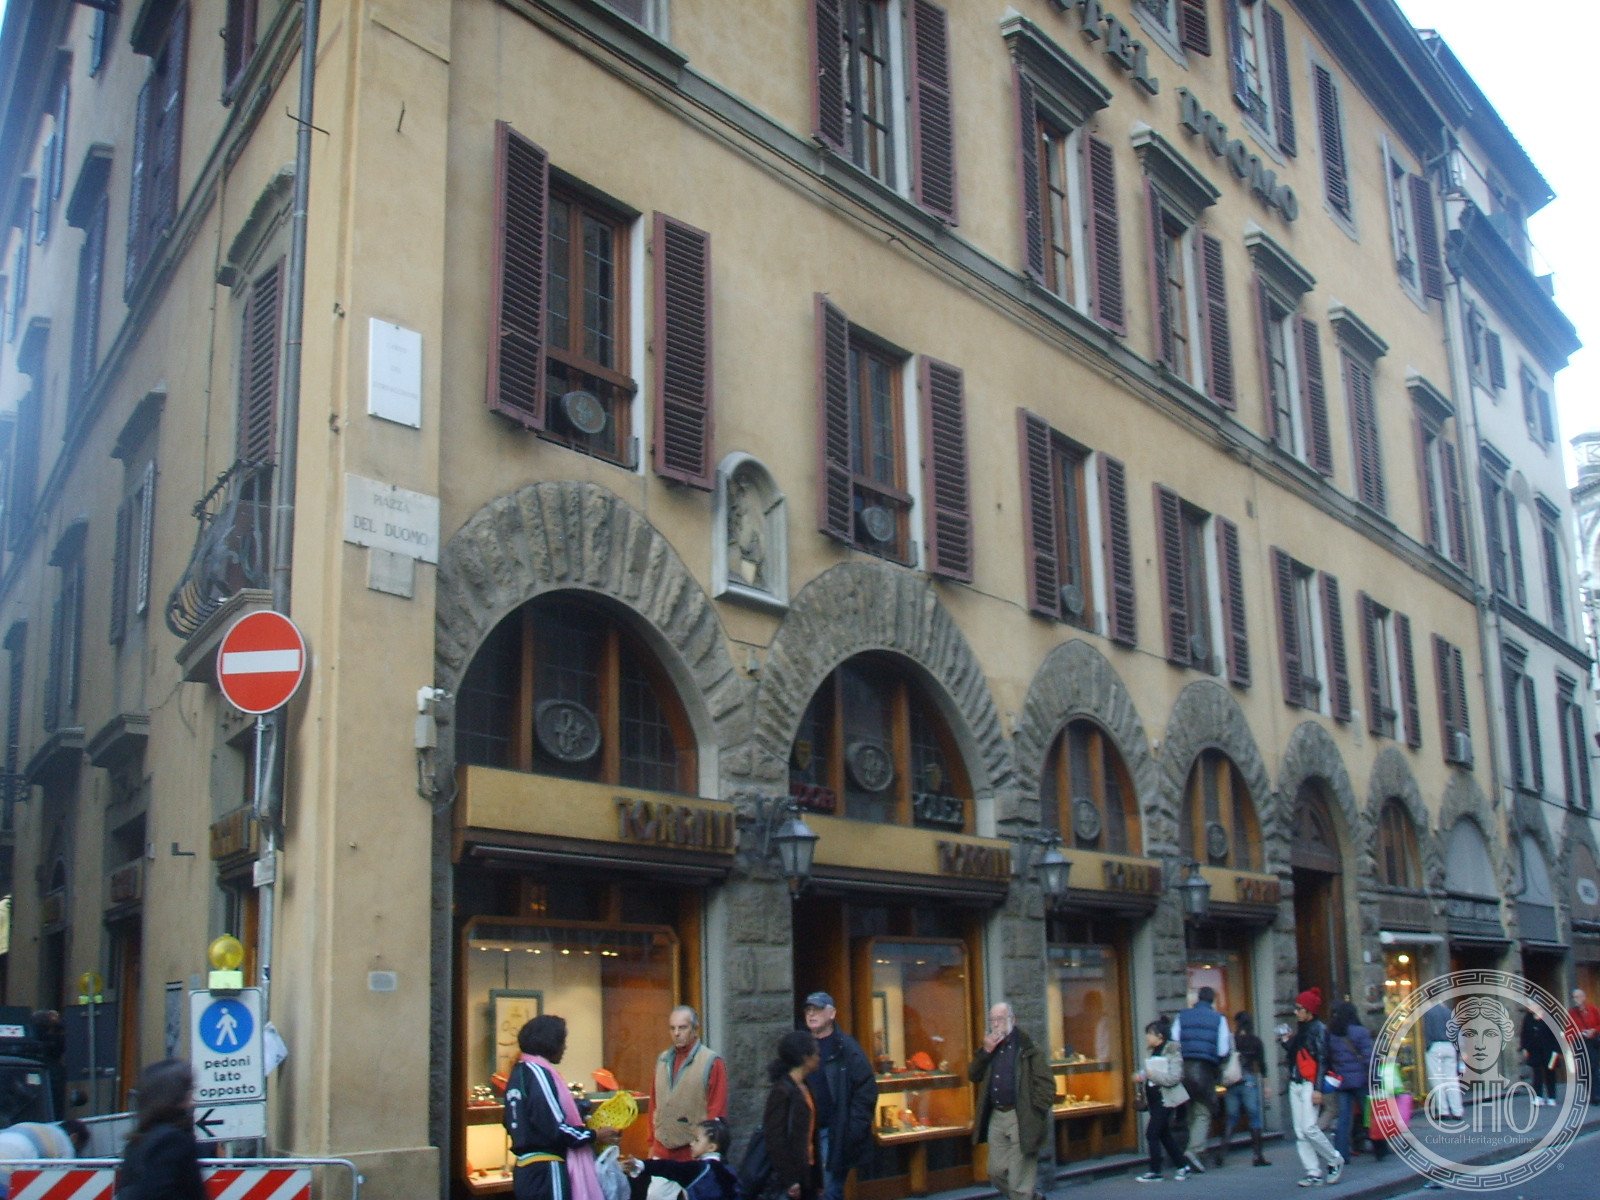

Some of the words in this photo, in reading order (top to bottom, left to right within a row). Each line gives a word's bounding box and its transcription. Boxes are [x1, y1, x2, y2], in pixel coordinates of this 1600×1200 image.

[1176, 86, 1299, 222] DUOMO
[373, 494, 410, 513] PIAZZA
[353, 514, 377, 533] DEL
[384, 523, 429, 546] DUOMO
[204, 1055, 251, 1070] pedoni
[214, 1071, 242, 1082] lato
[200, 1083, 257, 1098] opposto
